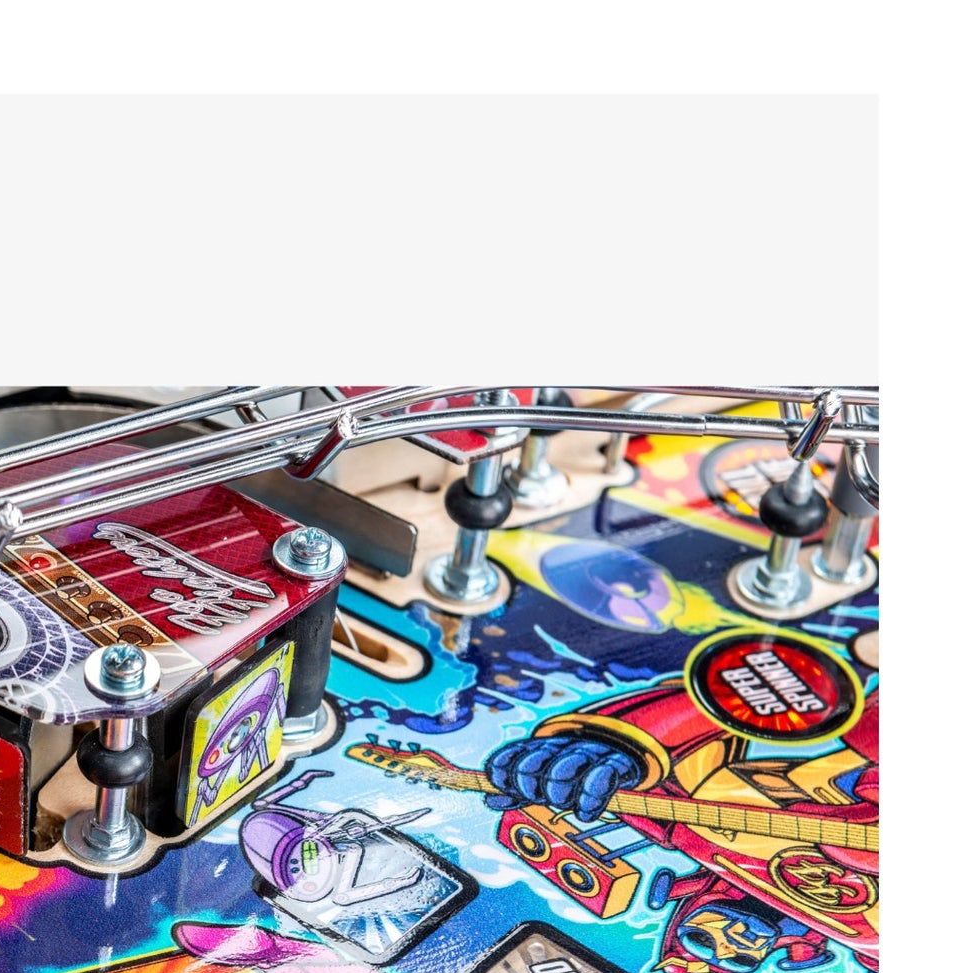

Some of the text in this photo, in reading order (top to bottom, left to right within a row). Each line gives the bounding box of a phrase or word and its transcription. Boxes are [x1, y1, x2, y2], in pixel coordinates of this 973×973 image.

[92, 526, 272, 625] Fighters
[148, 587, 223, 636] Foo
[720, 667, 788, 716] SUPER
[745, 651, 824, 713] SPINNER
